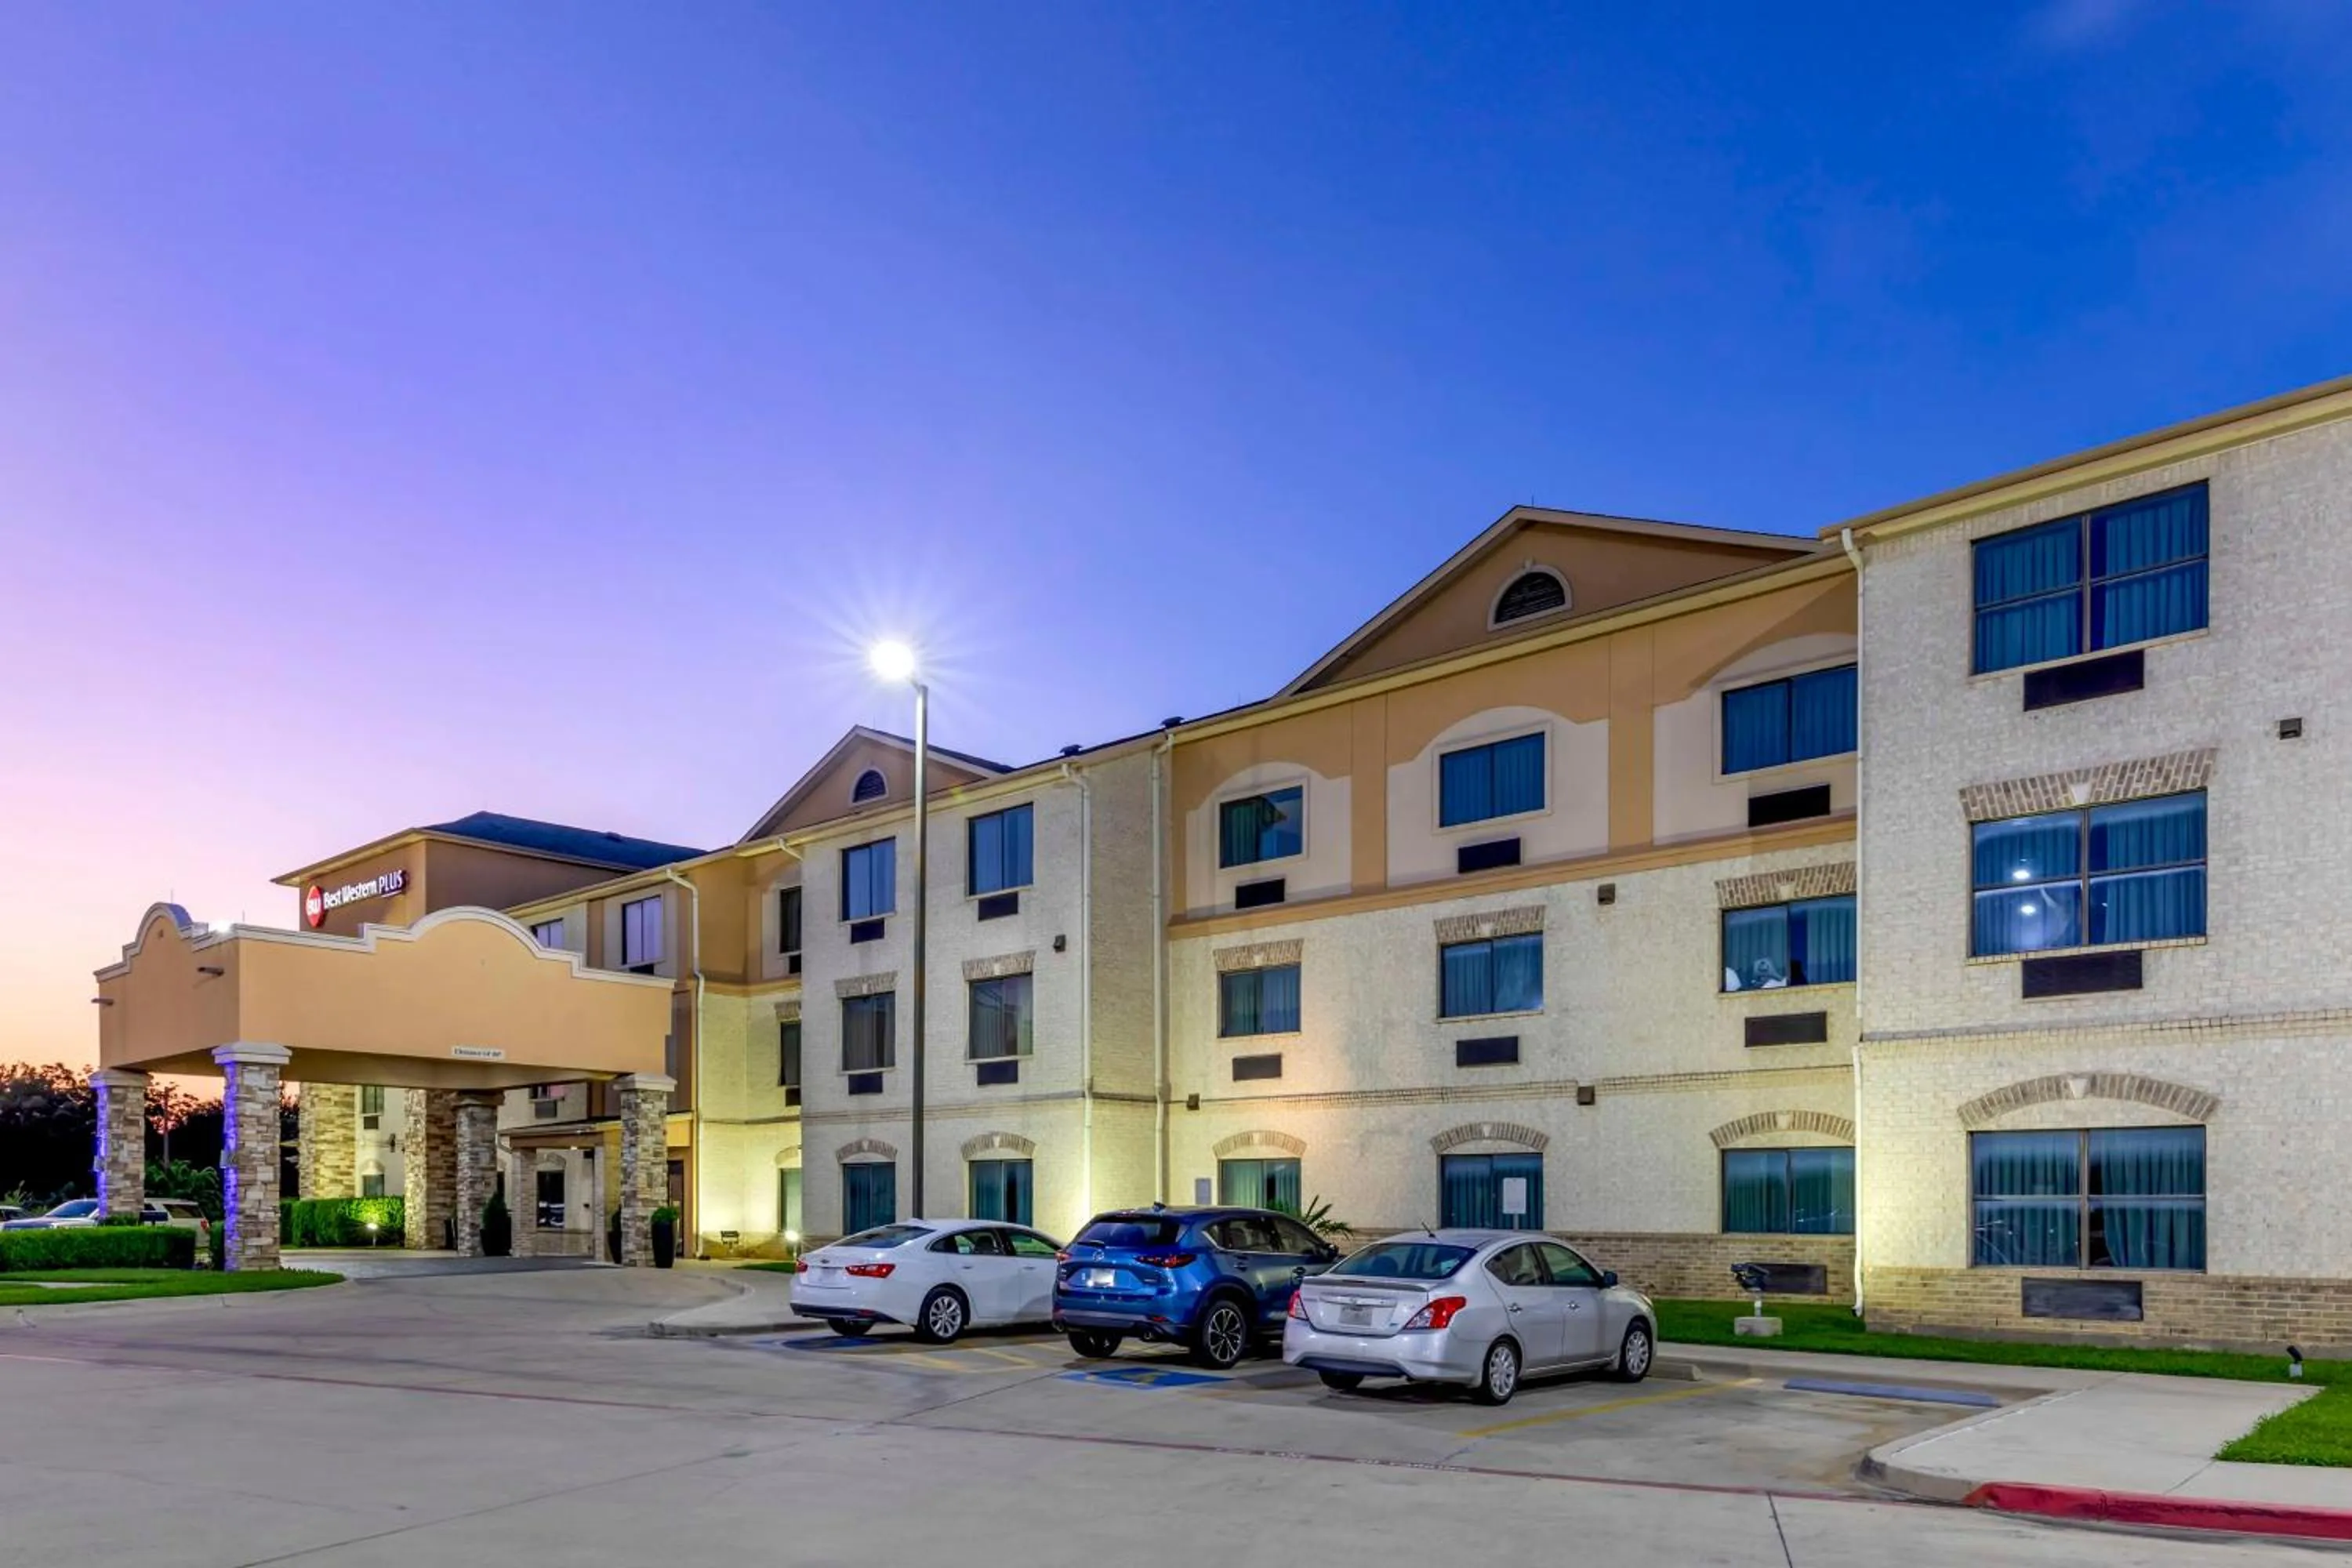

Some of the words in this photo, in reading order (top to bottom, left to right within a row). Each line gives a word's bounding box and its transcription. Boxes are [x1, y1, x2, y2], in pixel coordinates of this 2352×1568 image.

[323, 889, 343, 909] Best
[342, 880, 377, 902] Western
[379, 869, 403, 894] PLUS
